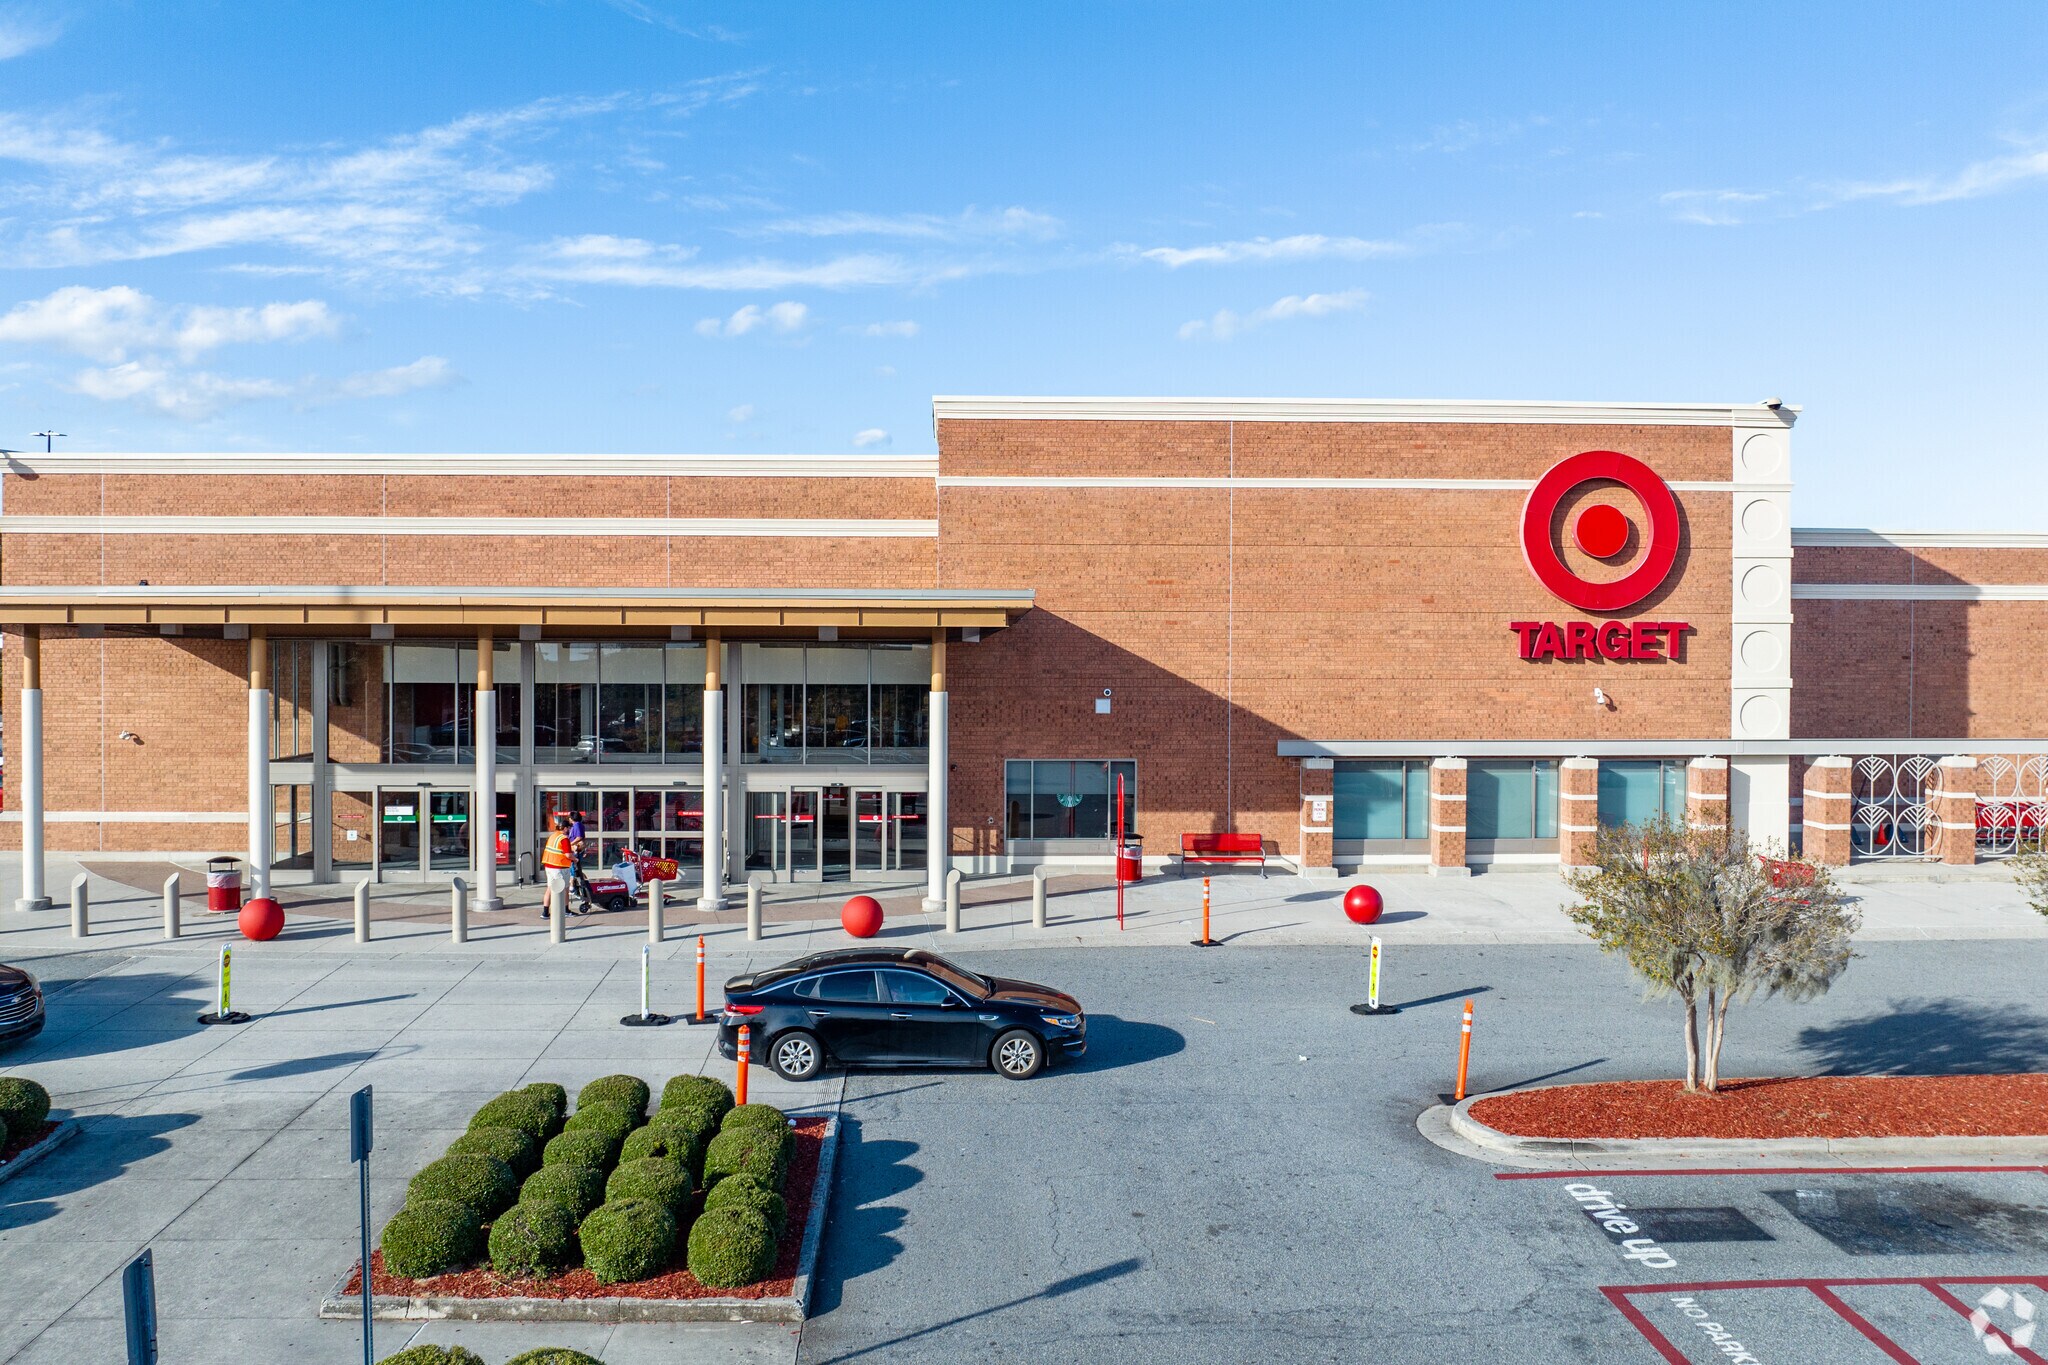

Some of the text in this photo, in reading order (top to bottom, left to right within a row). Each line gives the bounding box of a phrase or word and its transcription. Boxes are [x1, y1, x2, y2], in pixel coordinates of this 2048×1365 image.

[1509, 621, 1689, 659] TARGET
[1565, 1183, 1677, 1268] drive up
[1671, 1298, 1762, 1365] NO PARK
